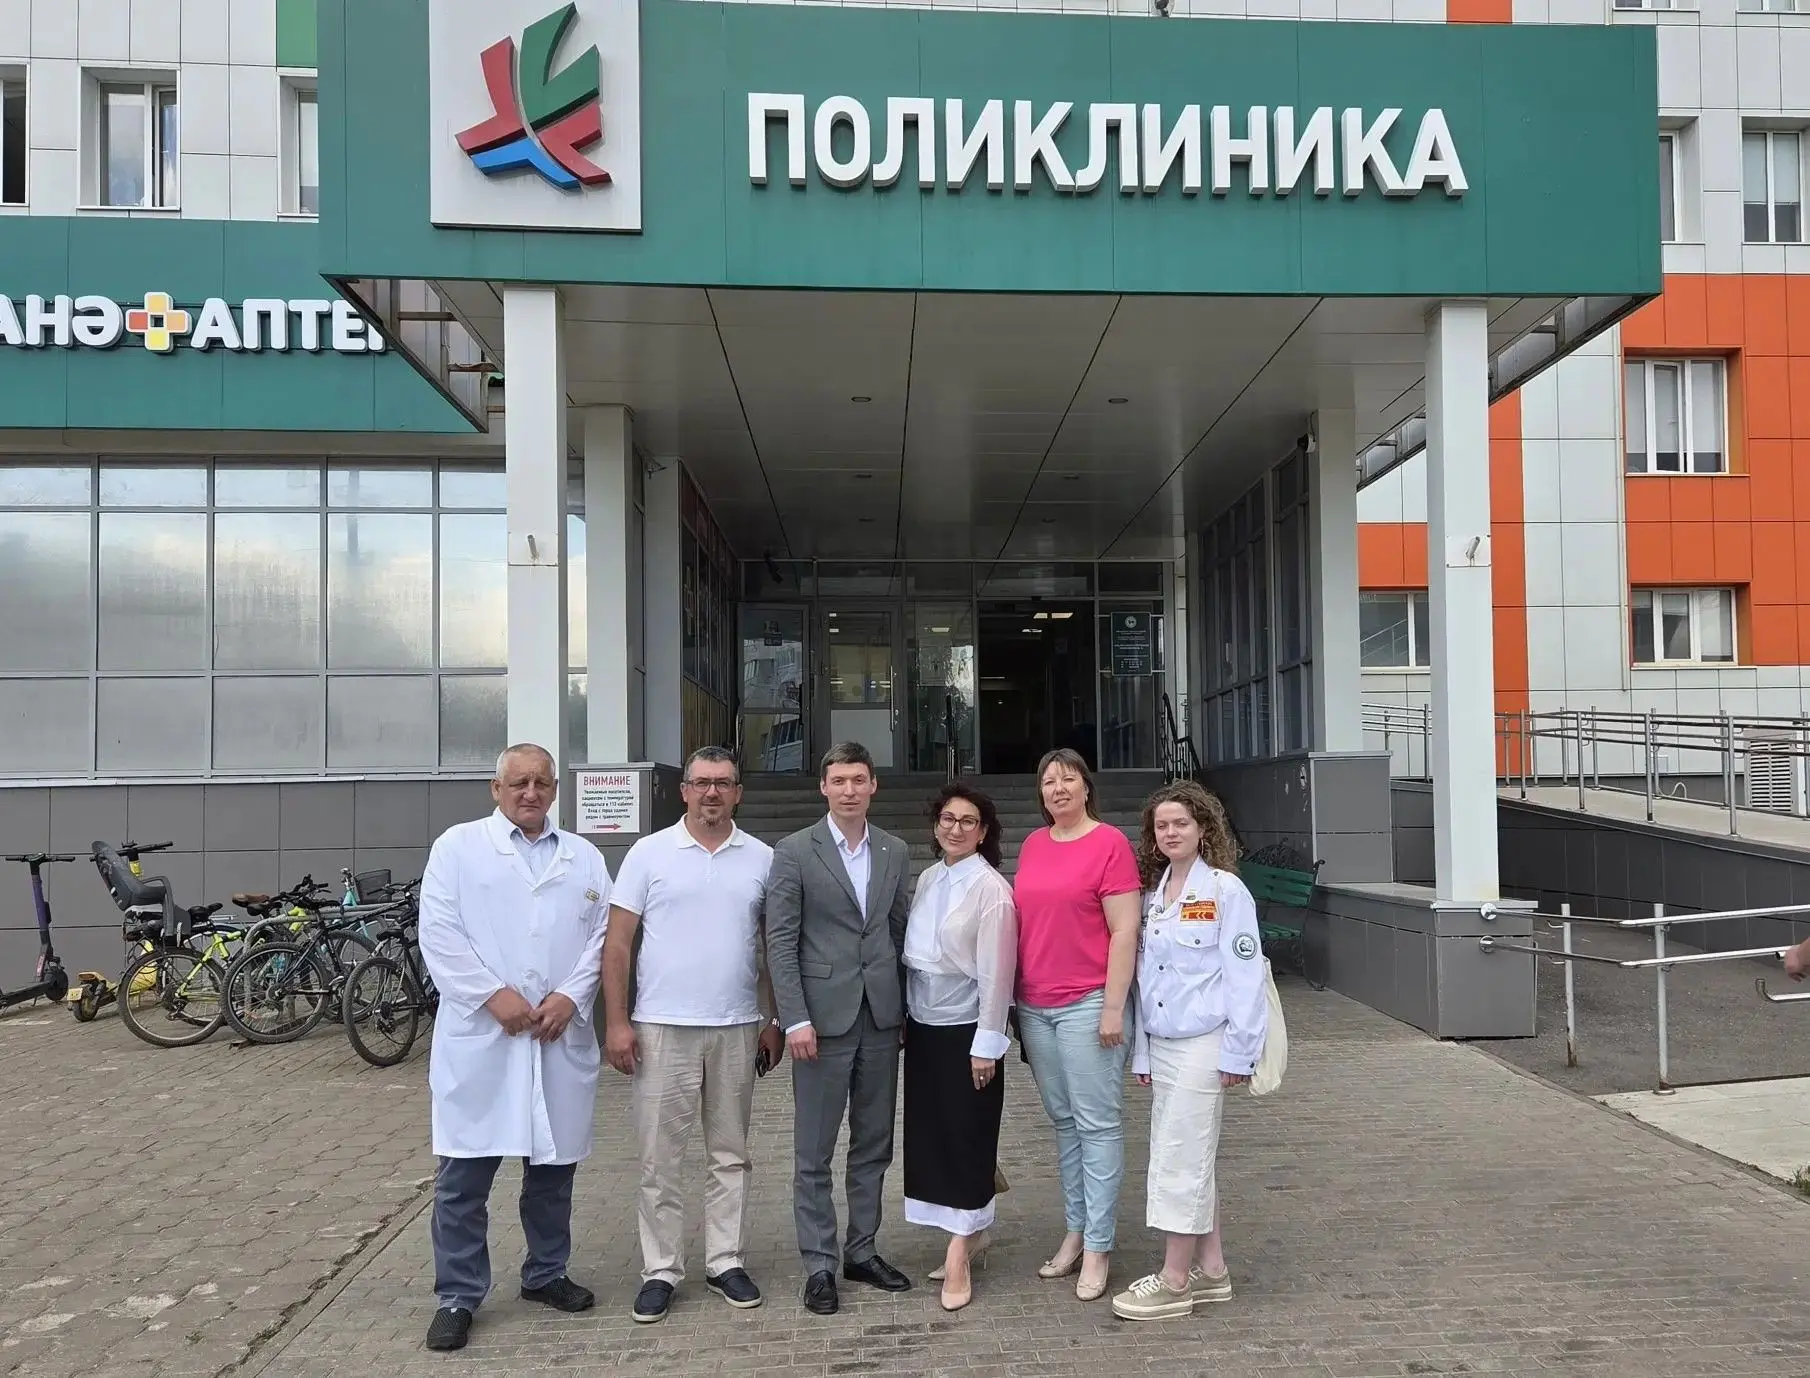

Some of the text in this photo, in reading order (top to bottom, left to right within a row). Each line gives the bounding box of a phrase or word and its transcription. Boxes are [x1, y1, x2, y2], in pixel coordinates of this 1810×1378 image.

[747, 92, 1469, 196] ПОЛИКЛИНИКА
[190, 297, 386, 353] АПТЕ
[584, 775, 631, 786] ВНИМАНИЕ
